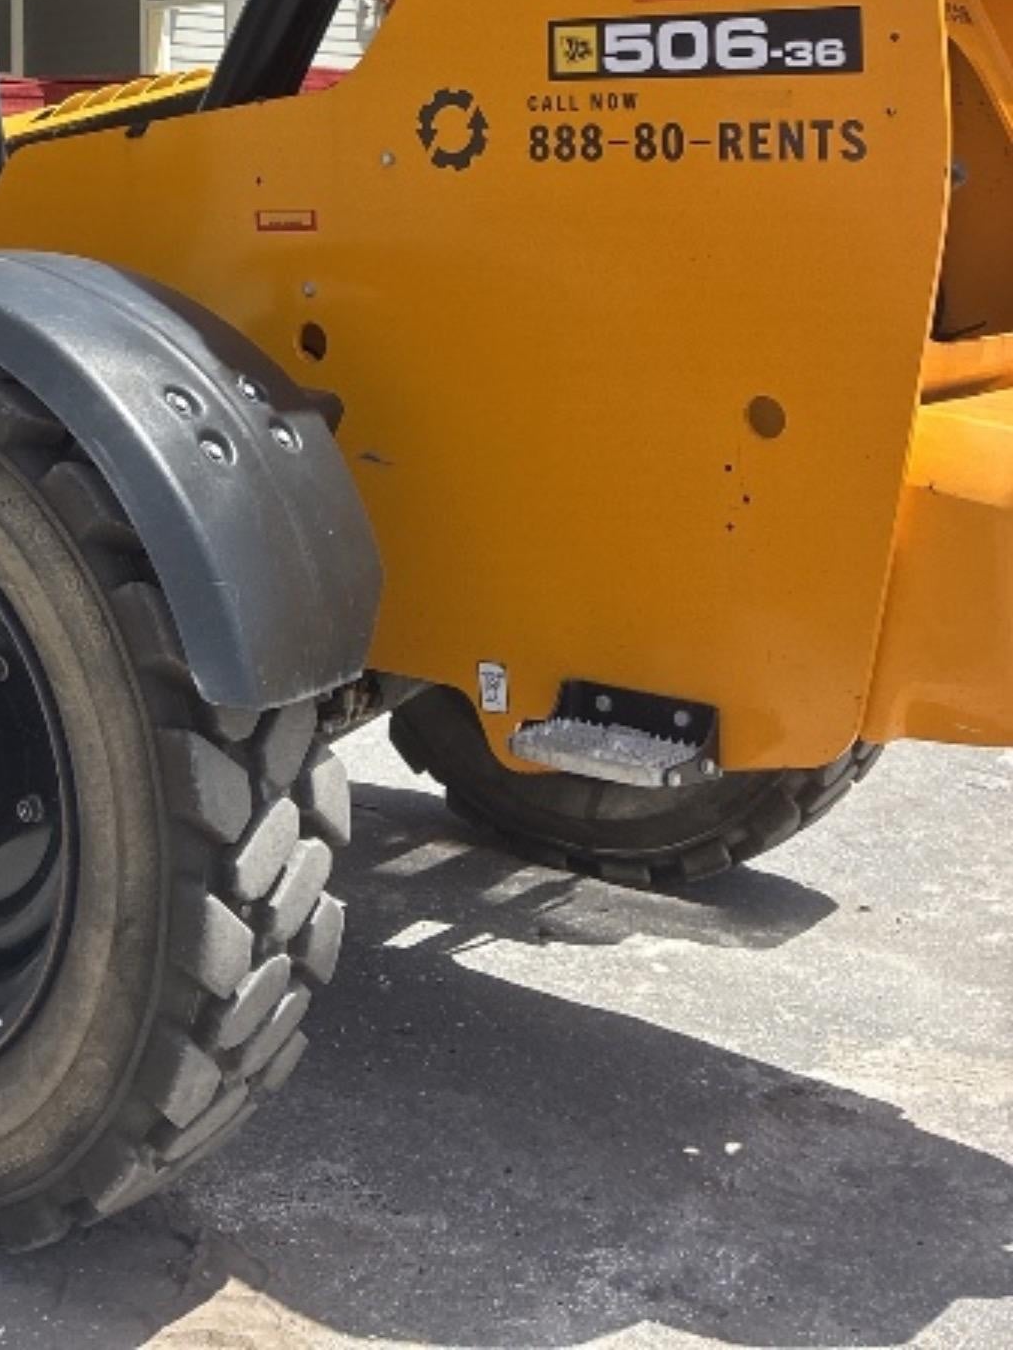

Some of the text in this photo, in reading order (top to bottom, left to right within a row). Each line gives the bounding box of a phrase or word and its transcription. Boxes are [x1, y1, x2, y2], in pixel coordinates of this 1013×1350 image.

[603, 17, 846, 73] 506-36
[527, 92, 638, 112] CALL NOW
[528, 118, 868, 163] 888-80-RENTS
